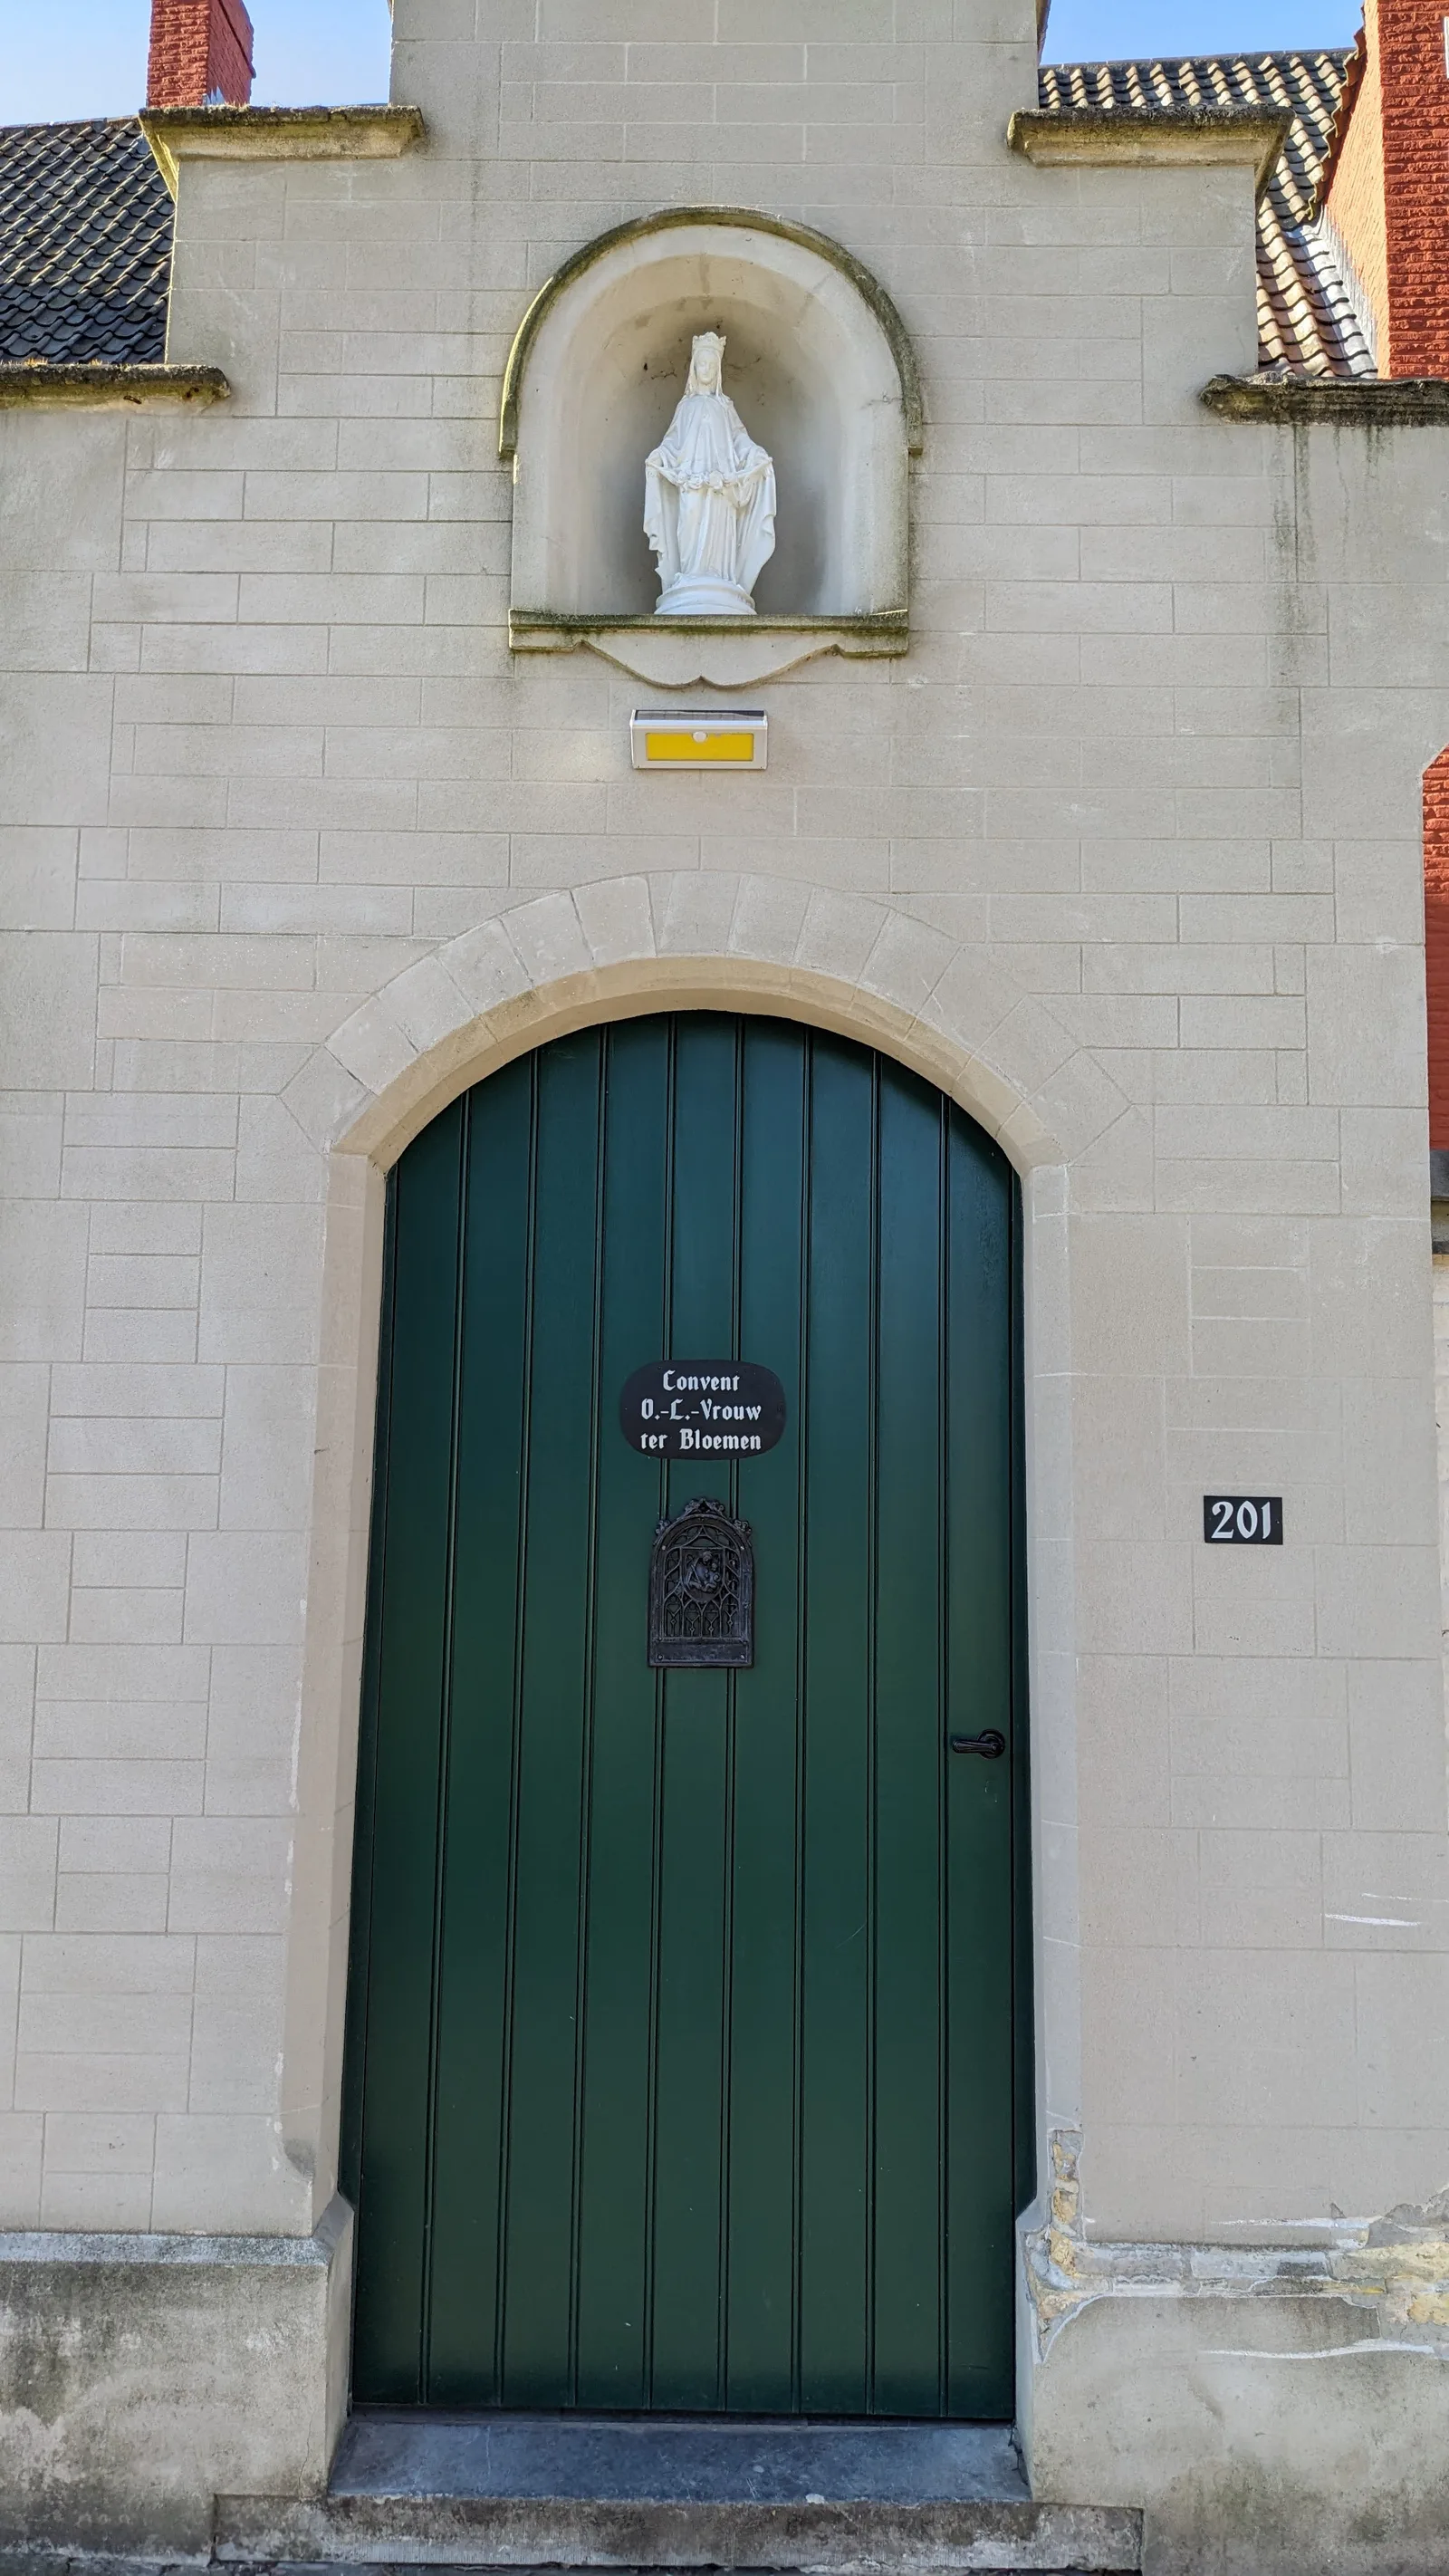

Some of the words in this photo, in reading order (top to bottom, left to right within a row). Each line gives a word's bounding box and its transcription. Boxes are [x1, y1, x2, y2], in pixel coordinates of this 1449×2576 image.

[663, 1370, 740, 1391] Convent
[640, 1432, 668, 1449] ter
[679, 1428, 762, 1449] Bloemen
[1211, 1500, 1271, 1539] 201
